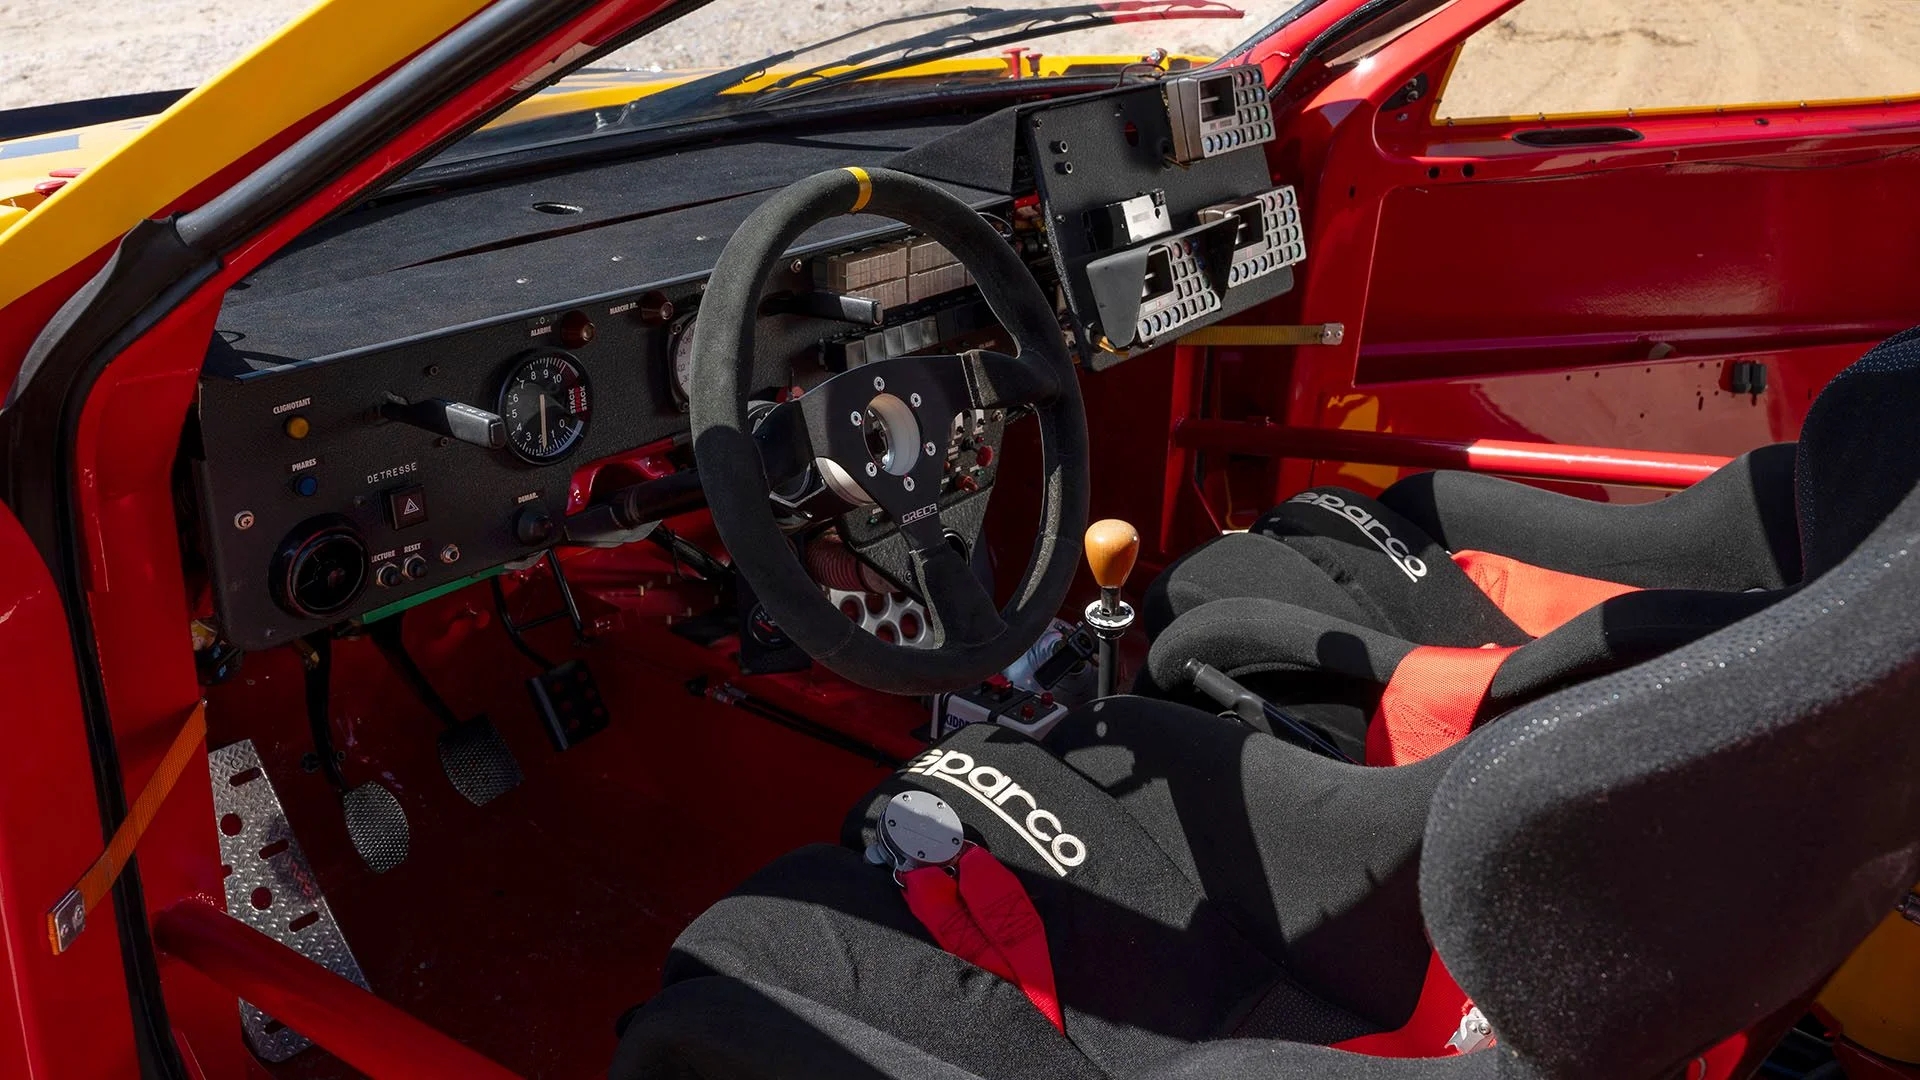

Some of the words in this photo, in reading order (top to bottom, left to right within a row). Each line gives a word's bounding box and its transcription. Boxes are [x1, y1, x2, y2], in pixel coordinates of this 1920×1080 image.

[531, 371, 537, 381] 8
[543, 369, 549, 379] 9
[552, 374, 562, 384] 10
[519, 380, 526, 390] 7
[512, 393, 519, 403] 6
[568, 388, 577, 415] STACK
[579, 385, 588, 412] STACK
[272, 397, 312, 415] CLIGNOTANT
[511, 408, 518, 419] 5
[516, 422, 522, 432] 4
[559, 418, 565, 429] 0
[525, 432, 532, 442] 3
[551, 429, 556, 439] 1
[291, 458, 317, 472] PHARES
[902, 503, 938, 524] ORECA
[403, 542, 422, 554] RESET
[370, 550, 396, 563] LECTURE
